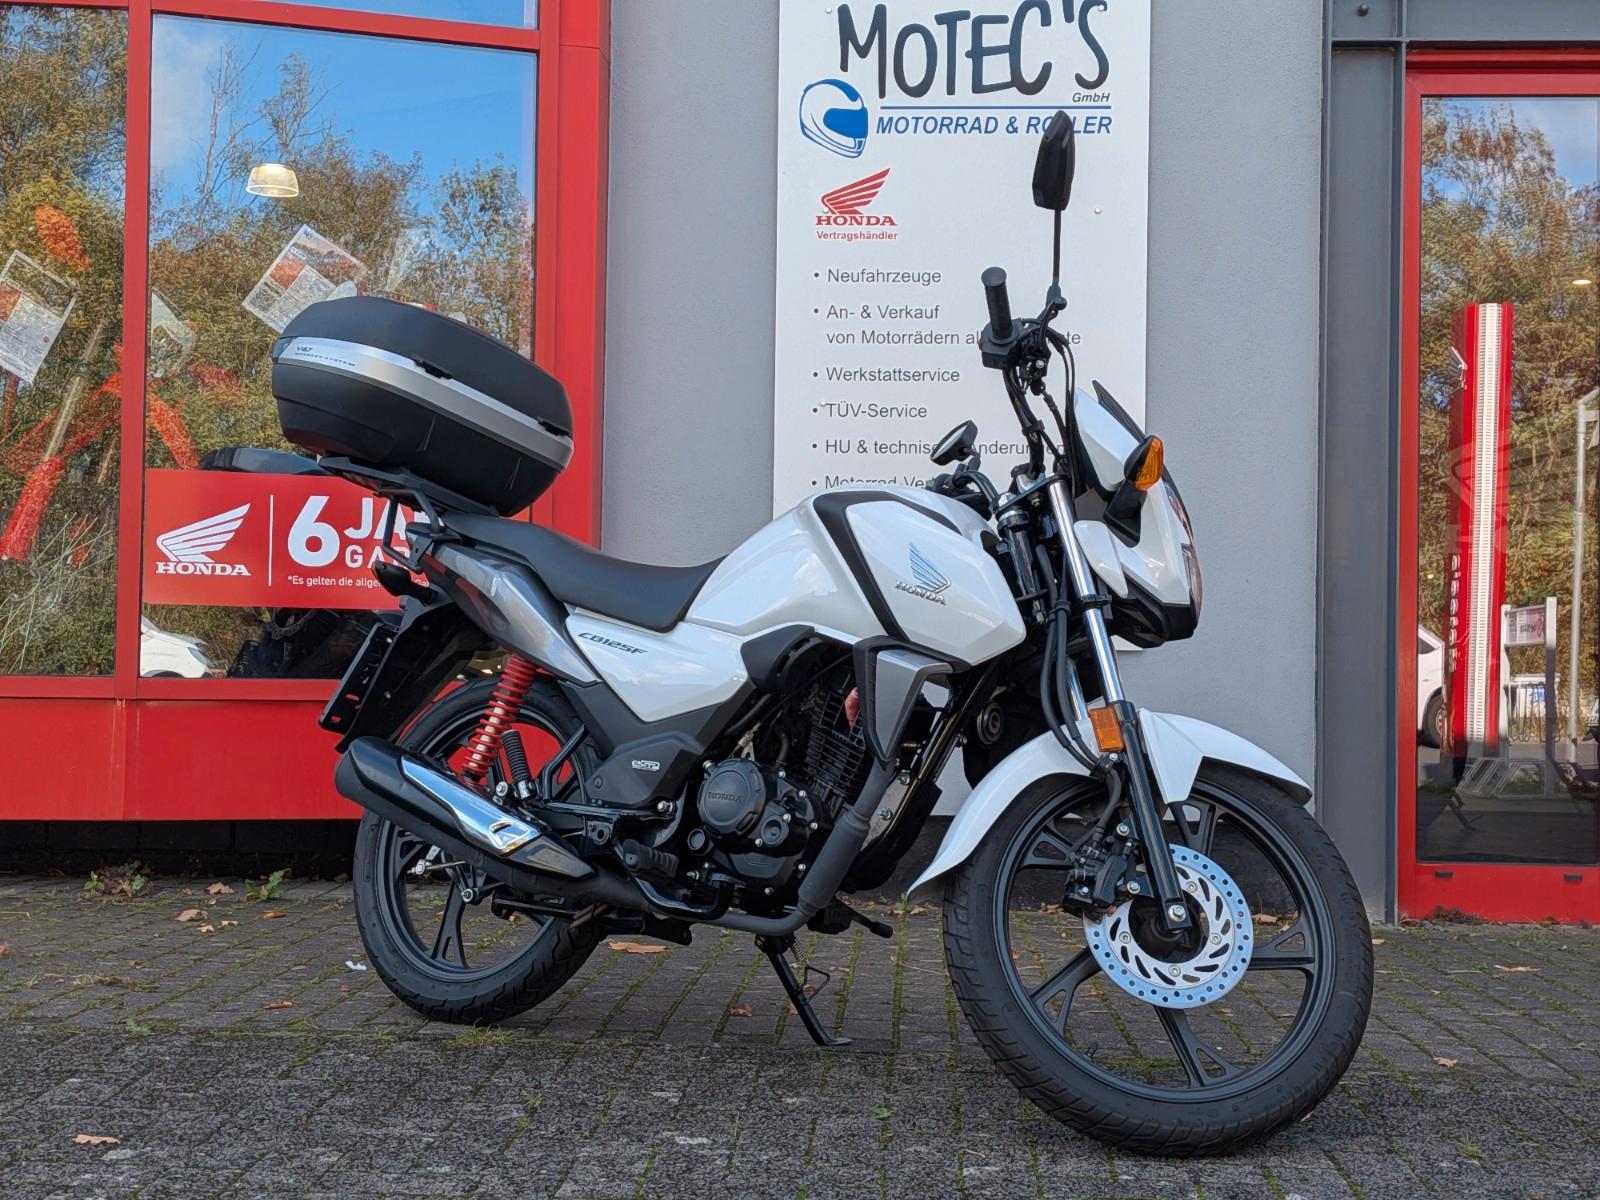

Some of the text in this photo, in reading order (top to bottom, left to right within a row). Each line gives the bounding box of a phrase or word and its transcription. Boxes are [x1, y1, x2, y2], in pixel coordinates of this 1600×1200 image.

[1072, 92, 1111, 103] GmbH
[876, 116, 999, 134] MOTORRAD
[1005, 116, 1019, 134] &
[815, 215, 897, 226] HONDA
[816, 230, 898, 241] Vertragshändler
[827, 268, 942, 286] Neufahrzeuge
[826, 304, 940, 319] An- & Verkauf
[826, 332, 855, 344] von
[861, 330, 960, 344] Motorrädern
[826, 367, 960, 382] Werkstattservice
[827, 401, 928, 418] TÜV-Service
[825, 439, 851, 454] HU
[856, 439, 868, 454] &
[288, 495, 340, 567] 6
[156, 561, 252, 576] HONDA
[306, 576, 336, 587] gelten
[339, 577, 353, 586] die
[895, 580, 947, 606] HONDA
[577, 632, 649, 654] CB125F
